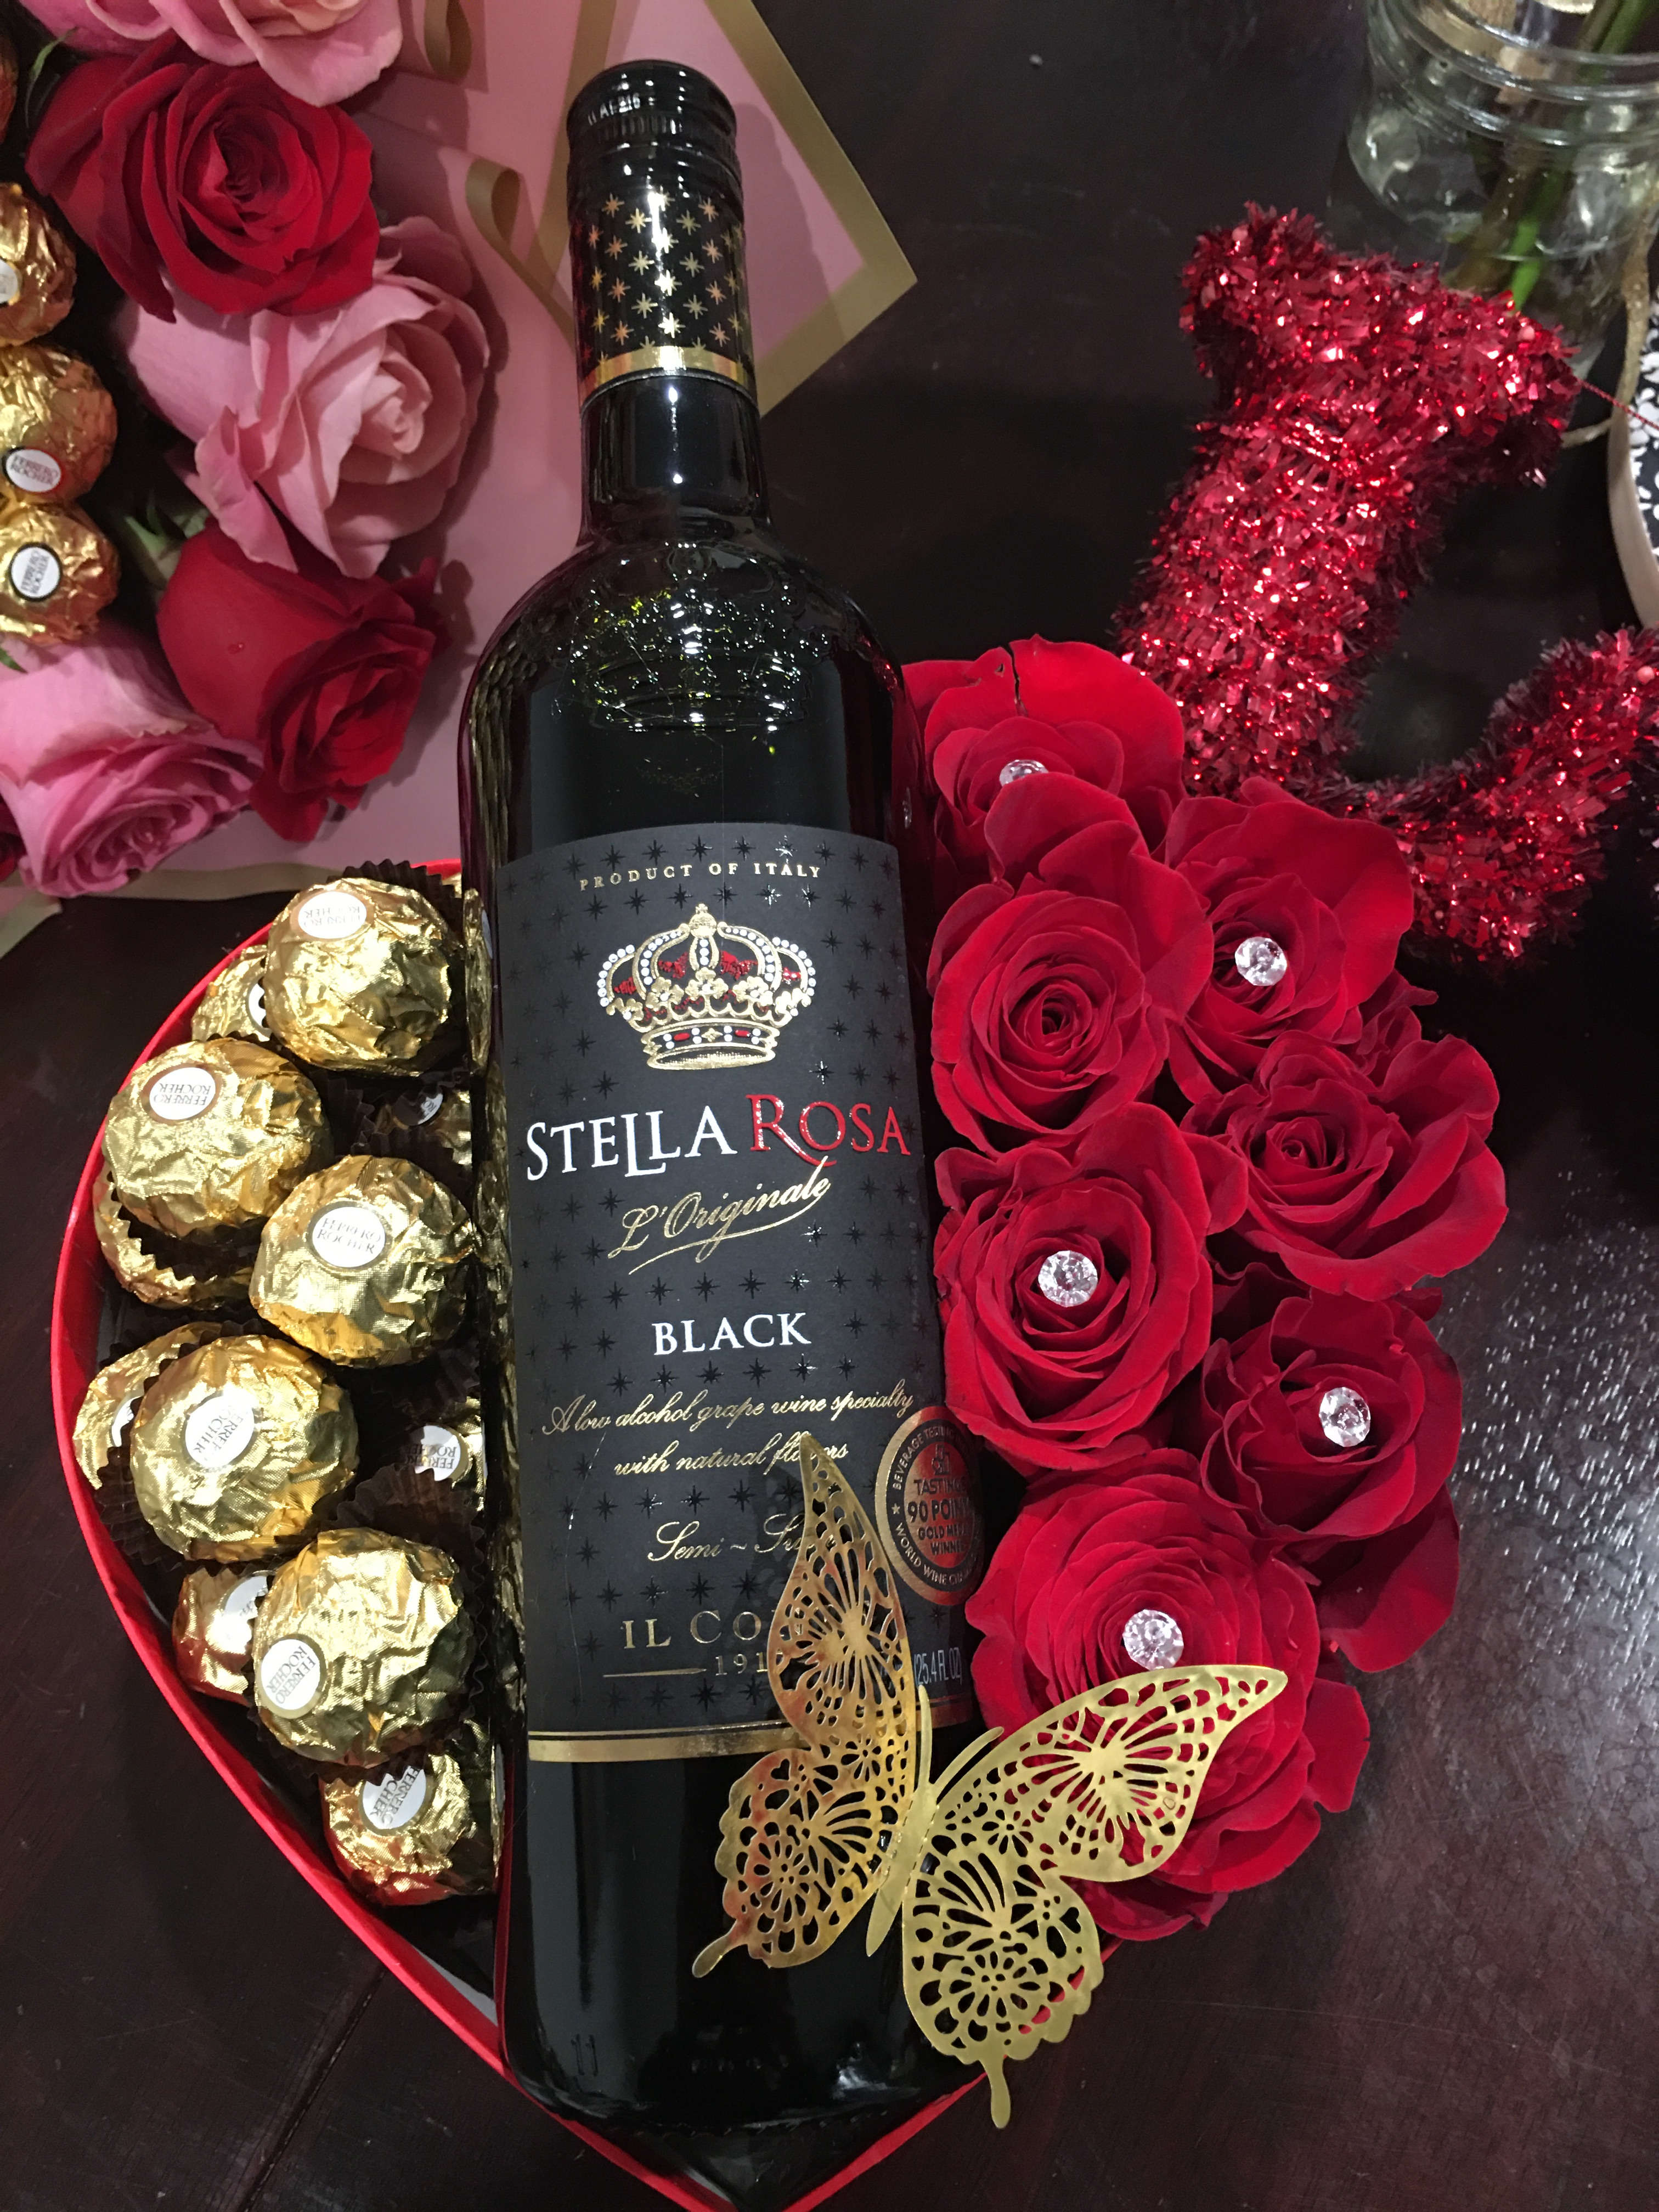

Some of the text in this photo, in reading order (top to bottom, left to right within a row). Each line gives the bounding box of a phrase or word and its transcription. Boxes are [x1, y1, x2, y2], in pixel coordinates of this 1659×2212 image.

[579, 861, 821, 891] PRODUCT OF ITALY
[154, 1094, 208, 1106] FERRERO
[159, 1082, 211, 1095] ROCHER
[526, 1093, 912, 1181] STELLA ROSA
[607, 1155, 832, 1268] L'Originale
[651, 1311, 812, 1356] BLACK
[541, 1378, 914, 1435] A low alcohol grape wine specialty
[613, 1431, 849, 1476] with natural flars
[892, 1432, 924, 1490] BEVERAGE
[907, 1500, 928, 1523] 90
[647, 1520, 723, 1561] Semi
[895, 1522, 947, 1585] WORLD WINE
[917, 1526, 945, 1541] GOLD
[930, 1539, 964, 1556] WINNE
[622, 1618, 672, 1649] IL
[266, 1646, 308, 1693] ROCHER
[275, 1656, 317, 1705] FERRERO
[715, 1649, 782, 1676] 191
[369, 1780, 398, 1817] CHER
